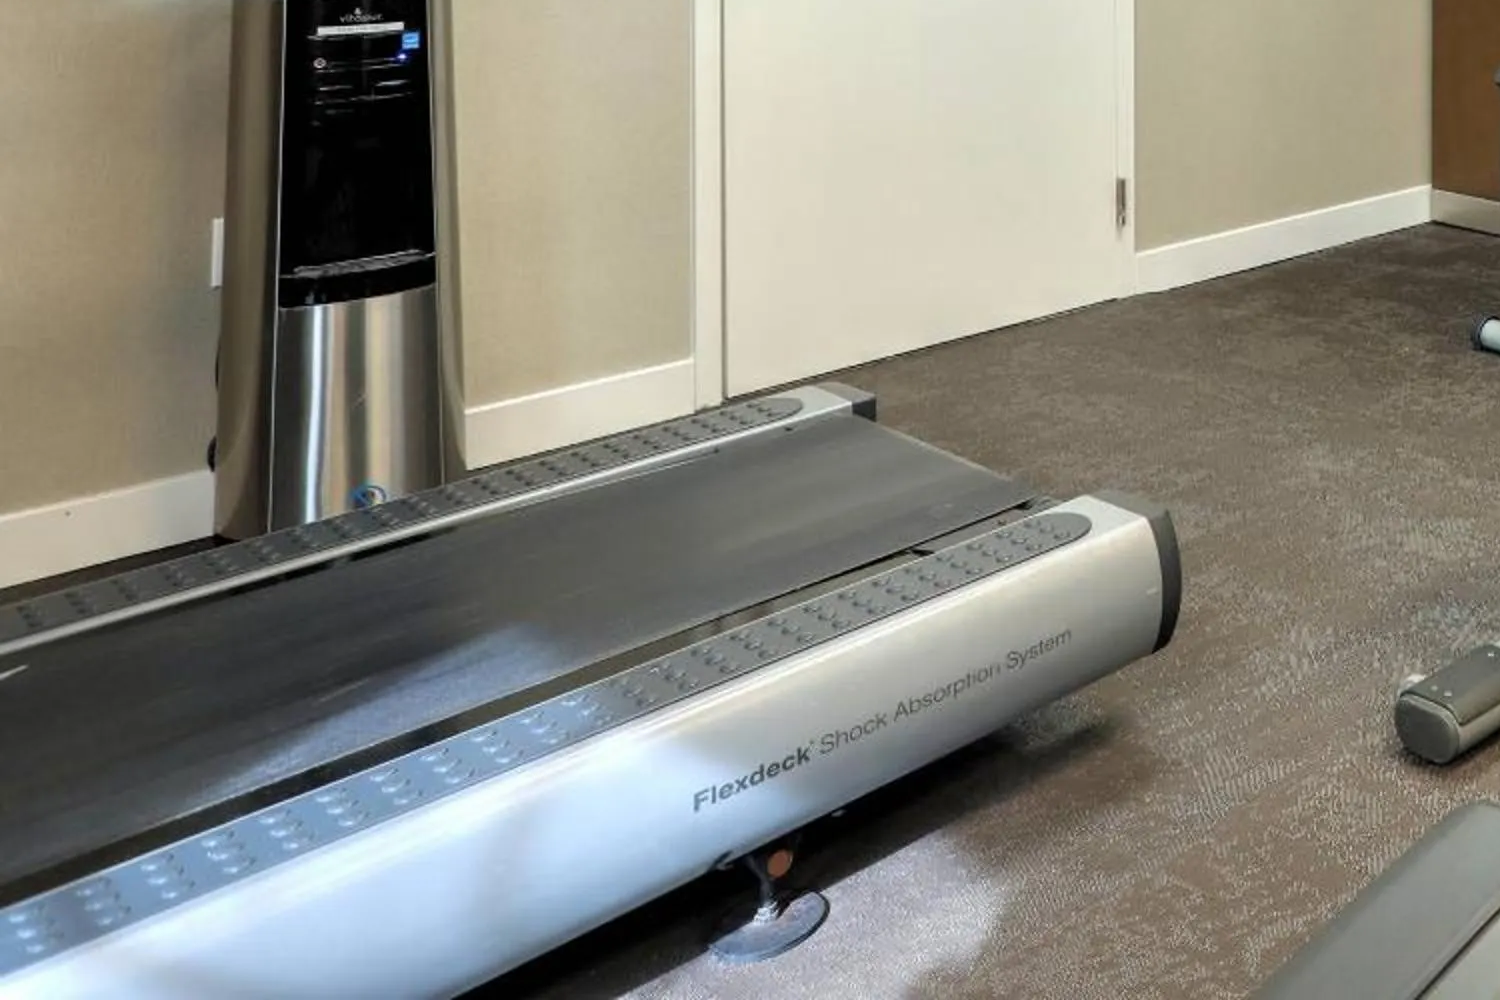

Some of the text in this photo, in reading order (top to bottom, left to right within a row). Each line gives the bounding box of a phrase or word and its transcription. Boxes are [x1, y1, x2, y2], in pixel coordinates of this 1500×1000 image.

[692, 628, 1073, 813] Flexdeck Shock Absorption System
